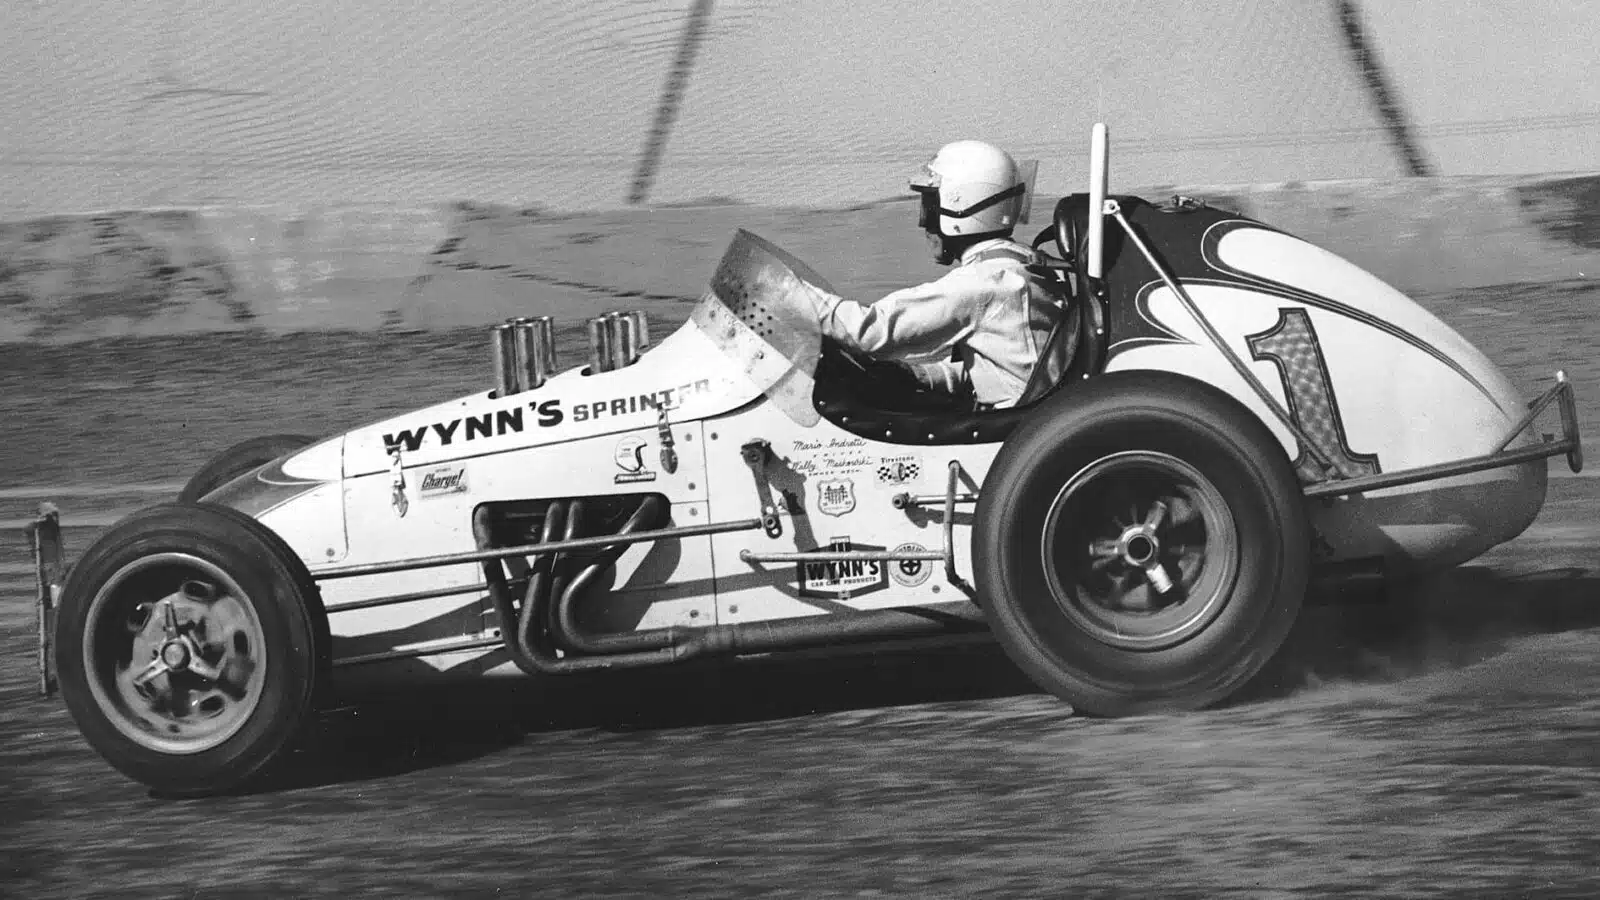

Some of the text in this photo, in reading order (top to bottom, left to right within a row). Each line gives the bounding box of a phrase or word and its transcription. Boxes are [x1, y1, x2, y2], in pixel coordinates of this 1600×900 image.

[1244, 307, 1383, 483] 1
[382, 399, 564, 455] WYNN'S
[793, 439, 822, 452] Mario
[881, 456, 914, 464] Firestone
[421, 468, 465, 490] Charge!
[806, 558, 879, 580] WYNN'S
